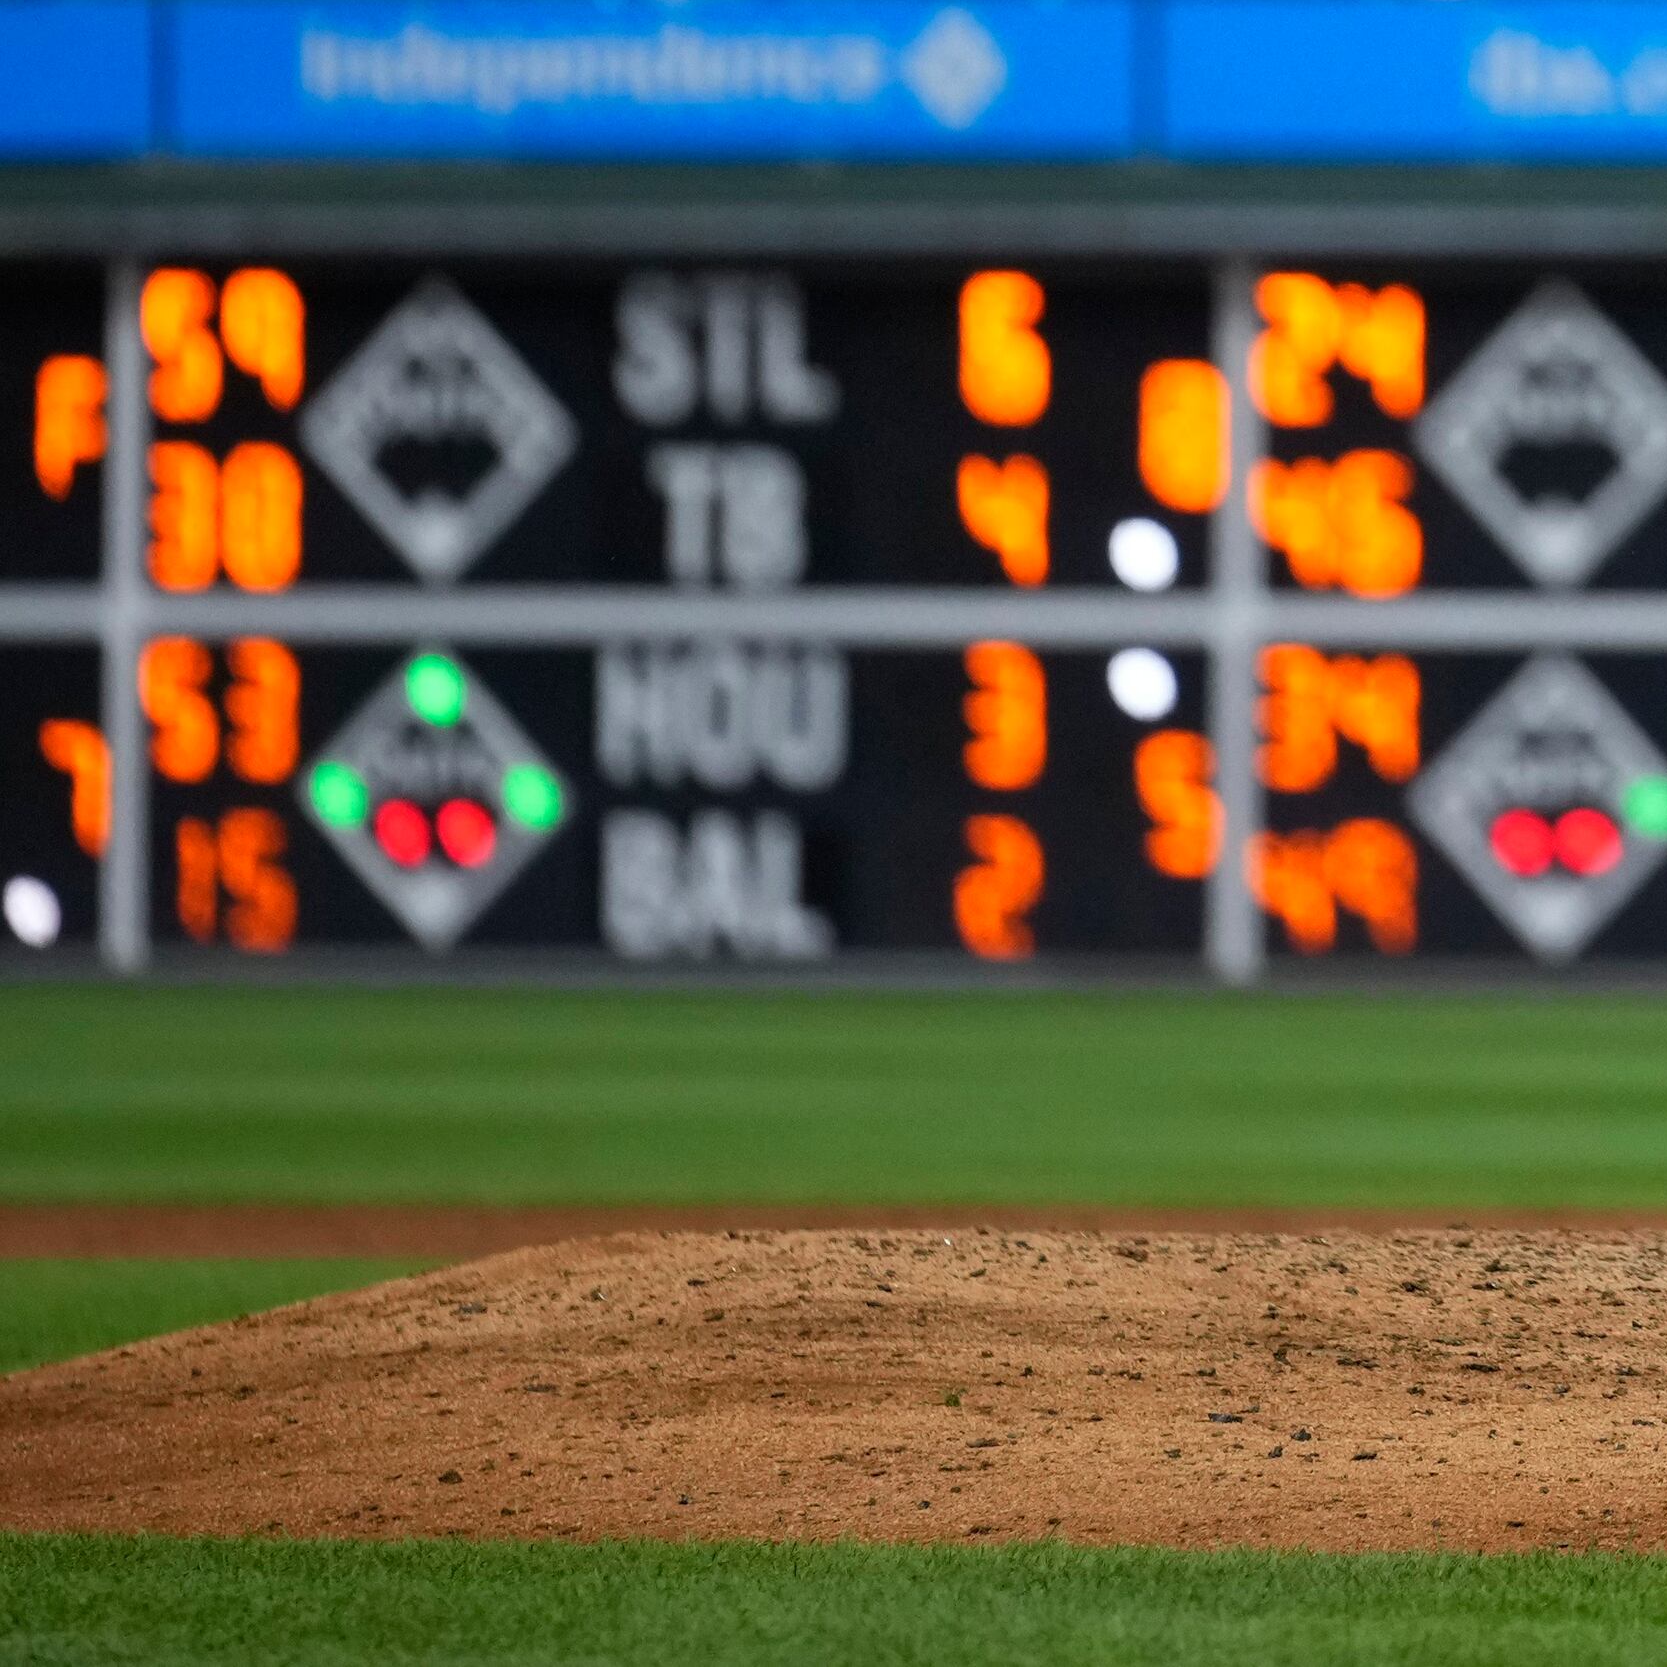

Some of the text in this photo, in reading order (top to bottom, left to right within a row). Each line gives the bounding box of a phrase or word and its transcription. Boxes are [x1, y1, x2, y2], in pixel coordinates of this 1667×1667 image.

[140, 268, 1053, 427] 59 STL 6
[1248, 270, 1427, 430] 24
[650, 442, 806, 590] TB
[956, 452, 1051, 588] 4
[1246, 447, 1424, 597] 46
[140, 637, 1048, 791] 53 HOU 3
[1258, 644, 1422, 794] 34
[1134, 729, 1224, 880] 5
[175, 807, 1046, 962] 15 BAL 2
[1244, 817, 1418, 954] 49
